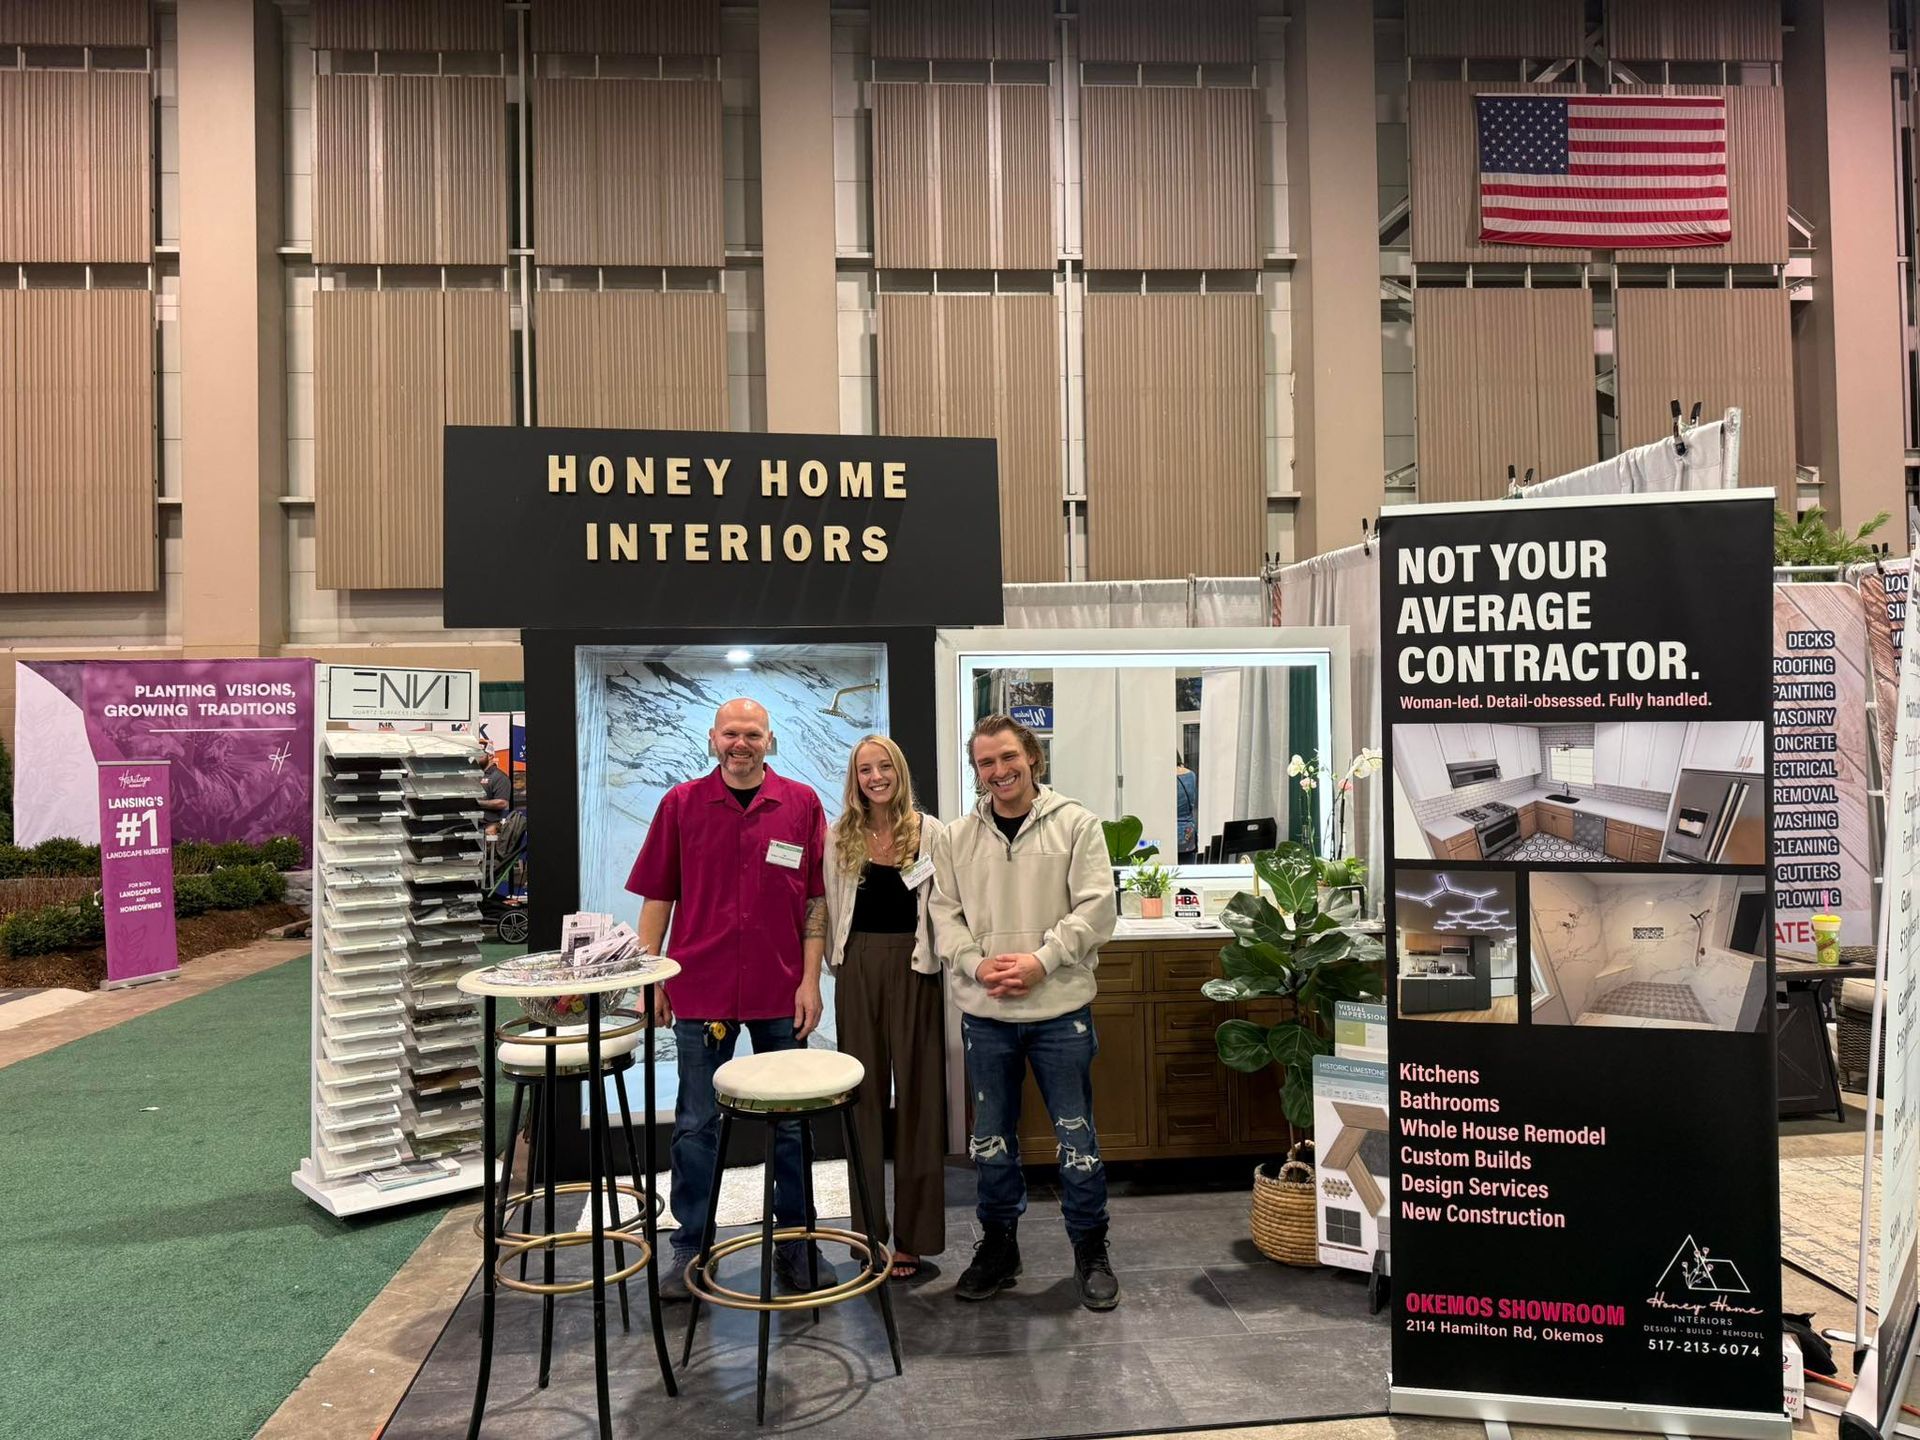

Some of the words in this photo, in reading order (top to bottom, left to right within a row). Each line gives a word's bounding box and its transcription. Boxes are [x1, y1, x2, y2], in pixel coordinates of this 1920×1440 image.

[548, 454, 732, 496] HONEY
[760, 460, 907, 498] HOME
[586, 523, 889, 562] INTERIORS
[1398, 545, 1480, 585] NOT
[1490, 540, 1607, 581] YOUR
[1396, 591, 1592, 634] AVERAGE
[1788, 633, 1834, 648] DECKS
[1398, 641, 1700, 684] CONTRACTOR.
[1774, 658, 1834, 673] ROOFING
[135, 684, 216, 699] PLANTING
[227, 683, 296, 698] VISIONS,
[104, 703, 189, 718] GROWING
[199, 702, 296, 716] TRADITIONS
[1400, 695, 1483, 710] Woman-led.
[1487, 694, 1606, 710] Detail-obsessed.
[1610, 692, 1643, 710] Fully
[1648, 692, 1712, 707] handled.
[1774, 736, 1835, 751] ONCRETE
[108, 796, 164, 809] LANSING'S
[1774, 788, 1836, 803] REMOVAL
[116, 809, 158, 847] #1
[106, 850, 142, 860] LANDSCAPE
[144, 848, 170, 856] NURSERY
[1777, 864, 1839, 880] GUTTERS
[119, 887, 160, 898] LANDSCAPERS
[1176, 896, 1200, 905] HBA
[120, 902, 162, 913] HOMEOWNERS
[1338, 1004, 1365, 1012] VISUAL
[1320, 1062, 1348, 1072] HISTORIC
[1400, 1062, 1480, 1084] Kitchens
[1400, 1090, 1500, 1112] Bathrooms
[1400, 1118, 1458, 1139] Whole
[1462, 1122, 1520, 1141] House
[1524, 1124, 1606, 1146] Remodel
[1401, 1146, 1470, 1168] Custom
[1475, 1150, 1532, 1170] Builds
[1402, 1174, 1464, 1198] Design
[1469, 1178, 1550, 1199] Services
[1402, 1202, 1441, 1222] New
[1446, 1204, 1566, 1228] Construction
[1406, 1292, 1493, 1318] OKEMOS
[1498, 1298, 1626, 1326] SHOWROOM
[1646, 1291, 1706, 1316] Honey
[1710, 1294, 1764, 1314] Home
[1674, 1316, 1733, 1326] INTERIORS
[1406, 1319, 1436, 1334] 2114
[1440, 1321, 1508, 1338] Hamilton
[1512, 1326, 1538, 1341] Rd,
[1542, 1328, 1604, 1344] Okemos
[1644, 1324, 1676, 1333] DESIGN
[1686, 1327, 1712, 1336] BUILD
[1722, 1330, 1765, 1340] REMODEL
[1648, 1339, 1760, 1358] 517-213-6074
